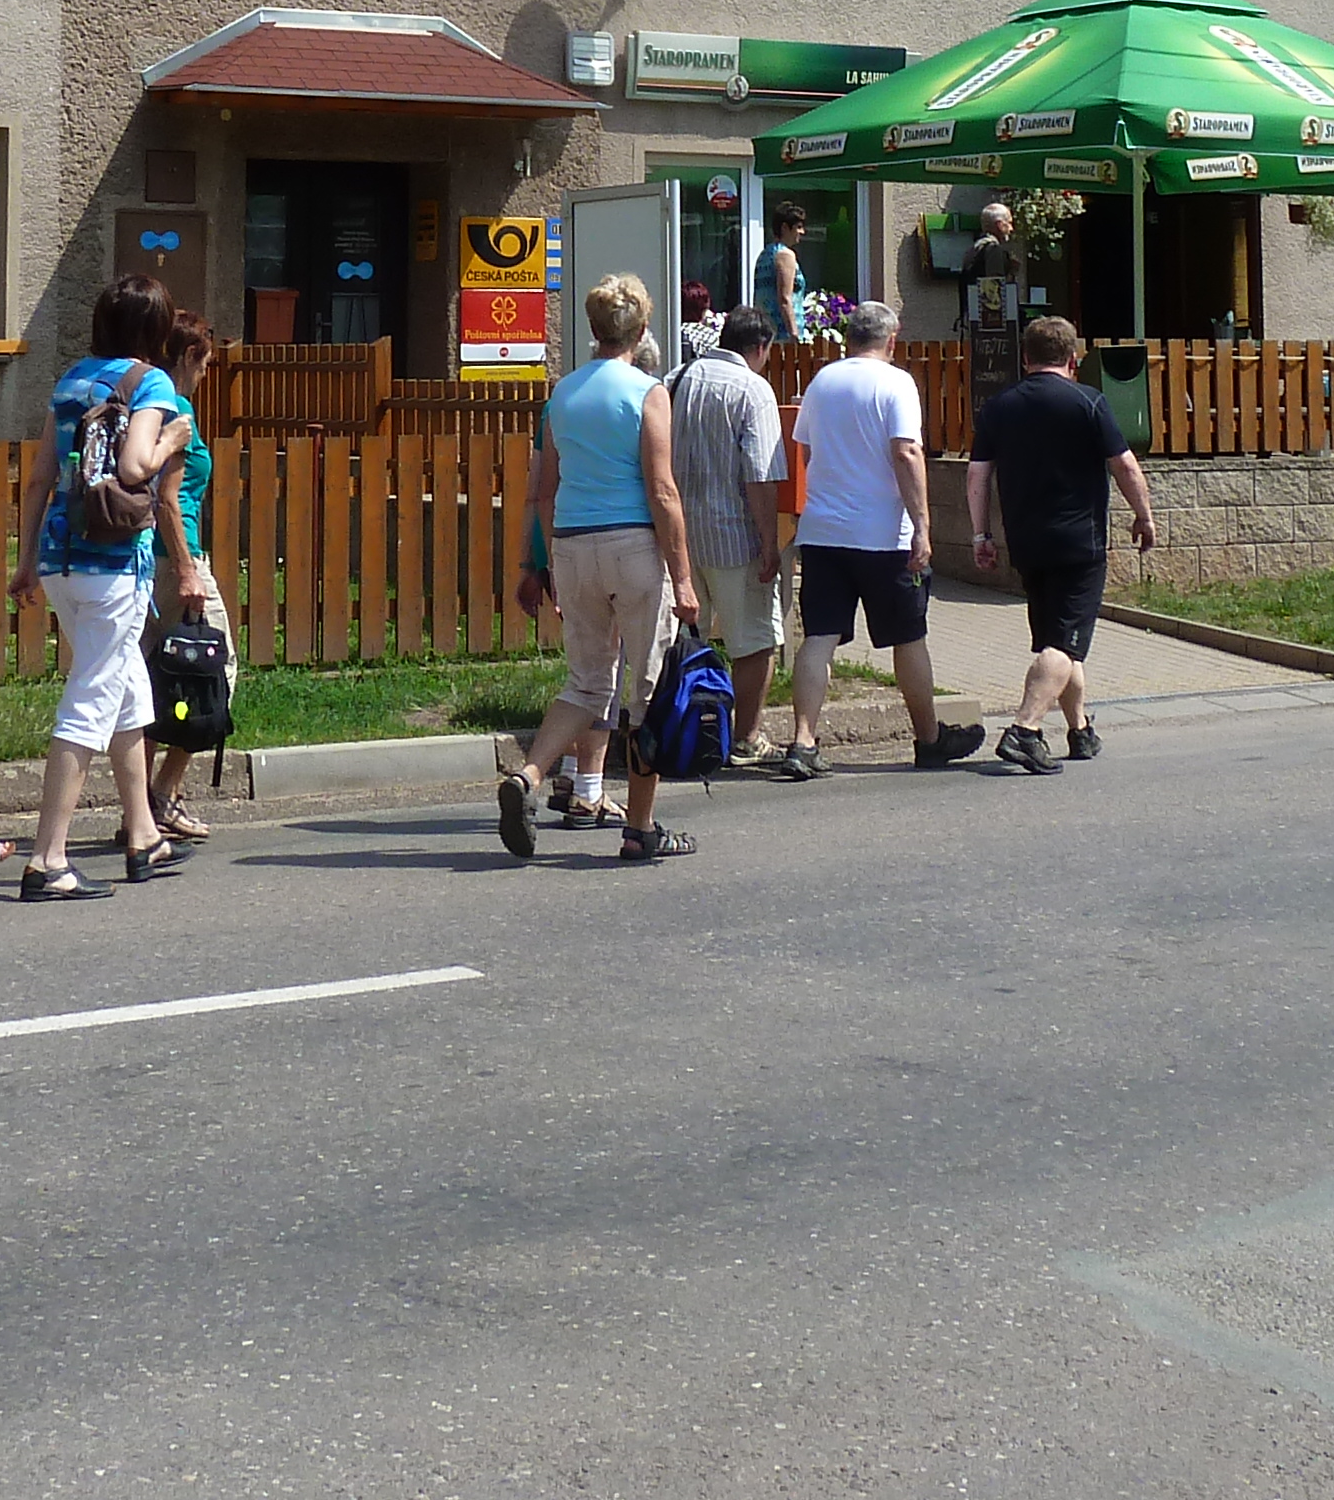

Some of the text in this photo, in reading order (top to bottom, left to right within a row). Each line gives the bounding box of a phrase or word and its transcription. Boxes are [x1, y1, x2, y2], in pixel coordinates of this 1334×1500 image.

[644, 44, 736, 70] STAROPRAMEN
[846, 70, 858, 85] LA
[466, 269, 502, 281] ČESKÁ
[504, 269, 540, 282] POŠTA
[464, 329, 500, 340] Poštovní
